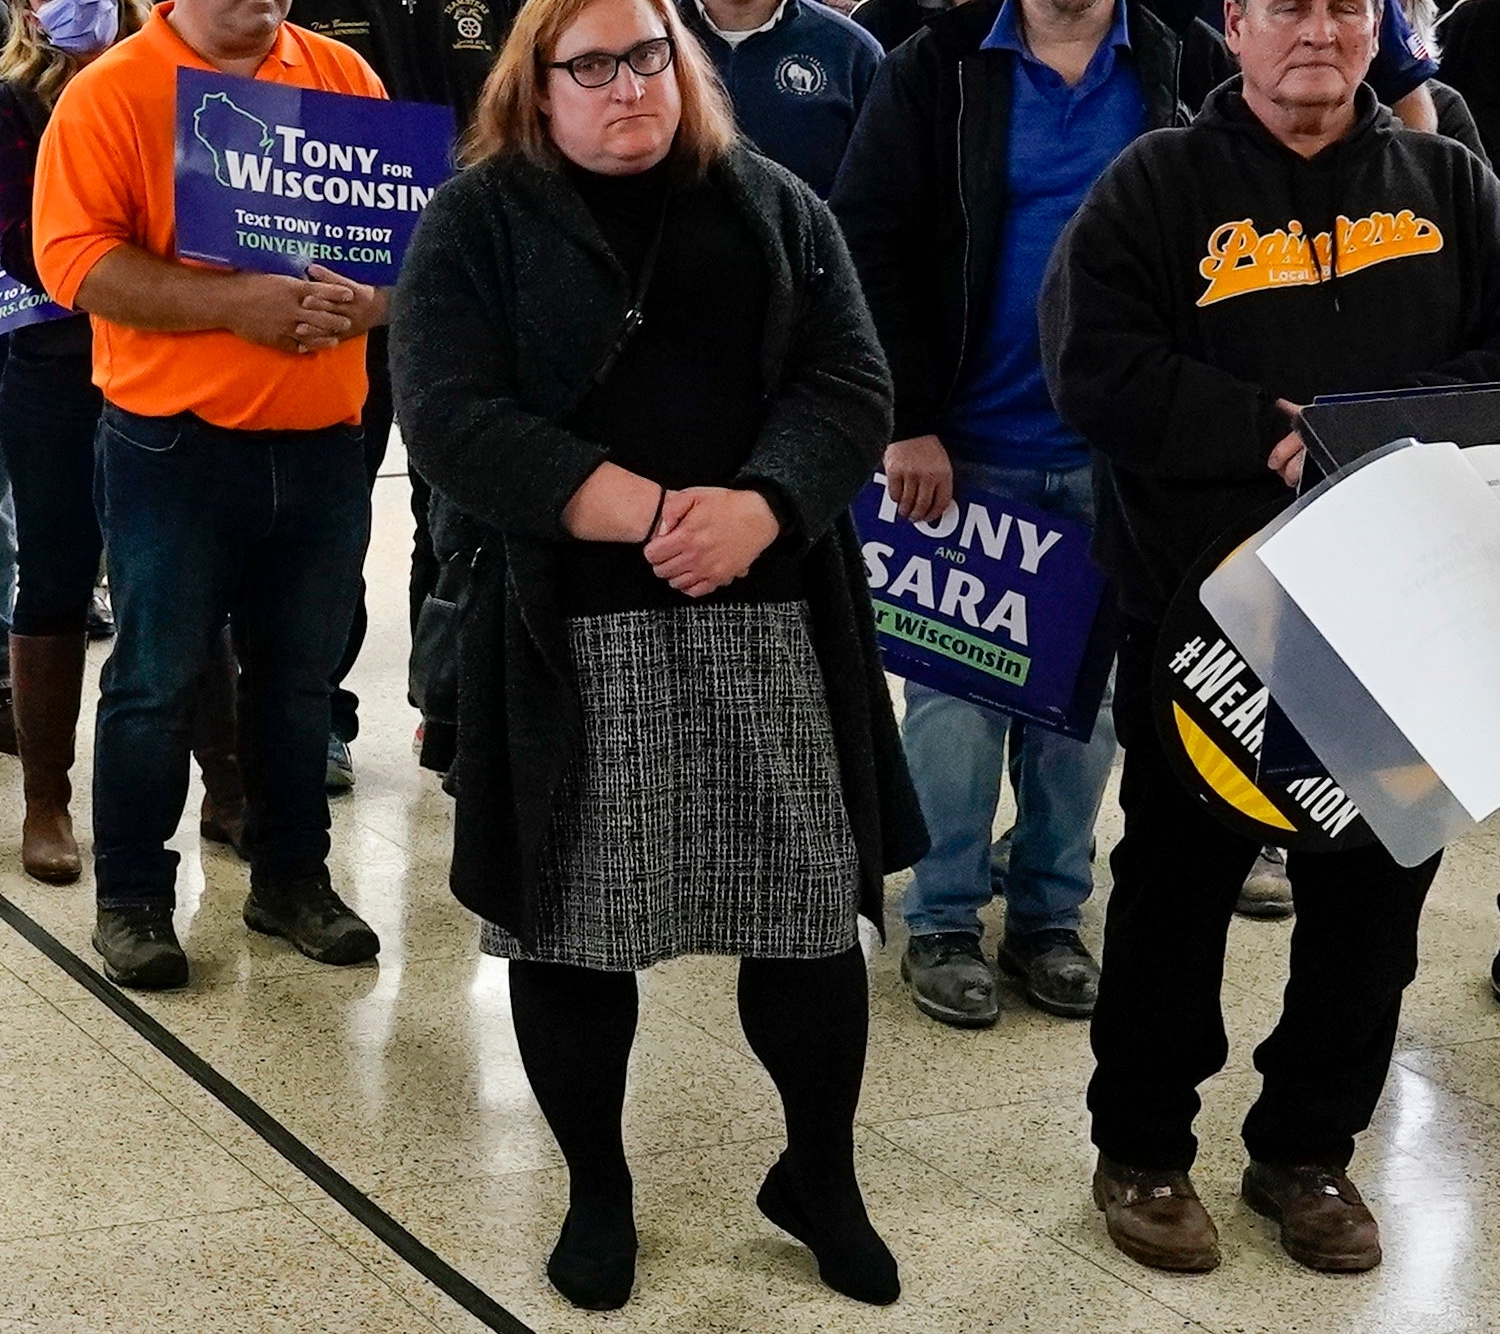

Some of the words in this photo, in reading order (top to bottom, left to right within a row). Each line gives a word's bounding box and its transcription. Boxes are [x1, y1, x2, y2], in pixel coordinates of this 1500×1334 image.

[382, 163, 413, 179] FOR
[234, 208, 272, 230] Text
[273, 215, 322, 237] TONY
[324, 224, 344, 240] to
[346, 225, 393, 244] 73107
[236, 230, 393, 265] TONYEVERS.COM
[1269, 267, 1310, 283] Local
[4, 287, 18, 301] to
[935, 546, 966, 565] AND
[861, 541, 1028, 647] SARA
[895, 611, 1022, 678] Wisconsin
